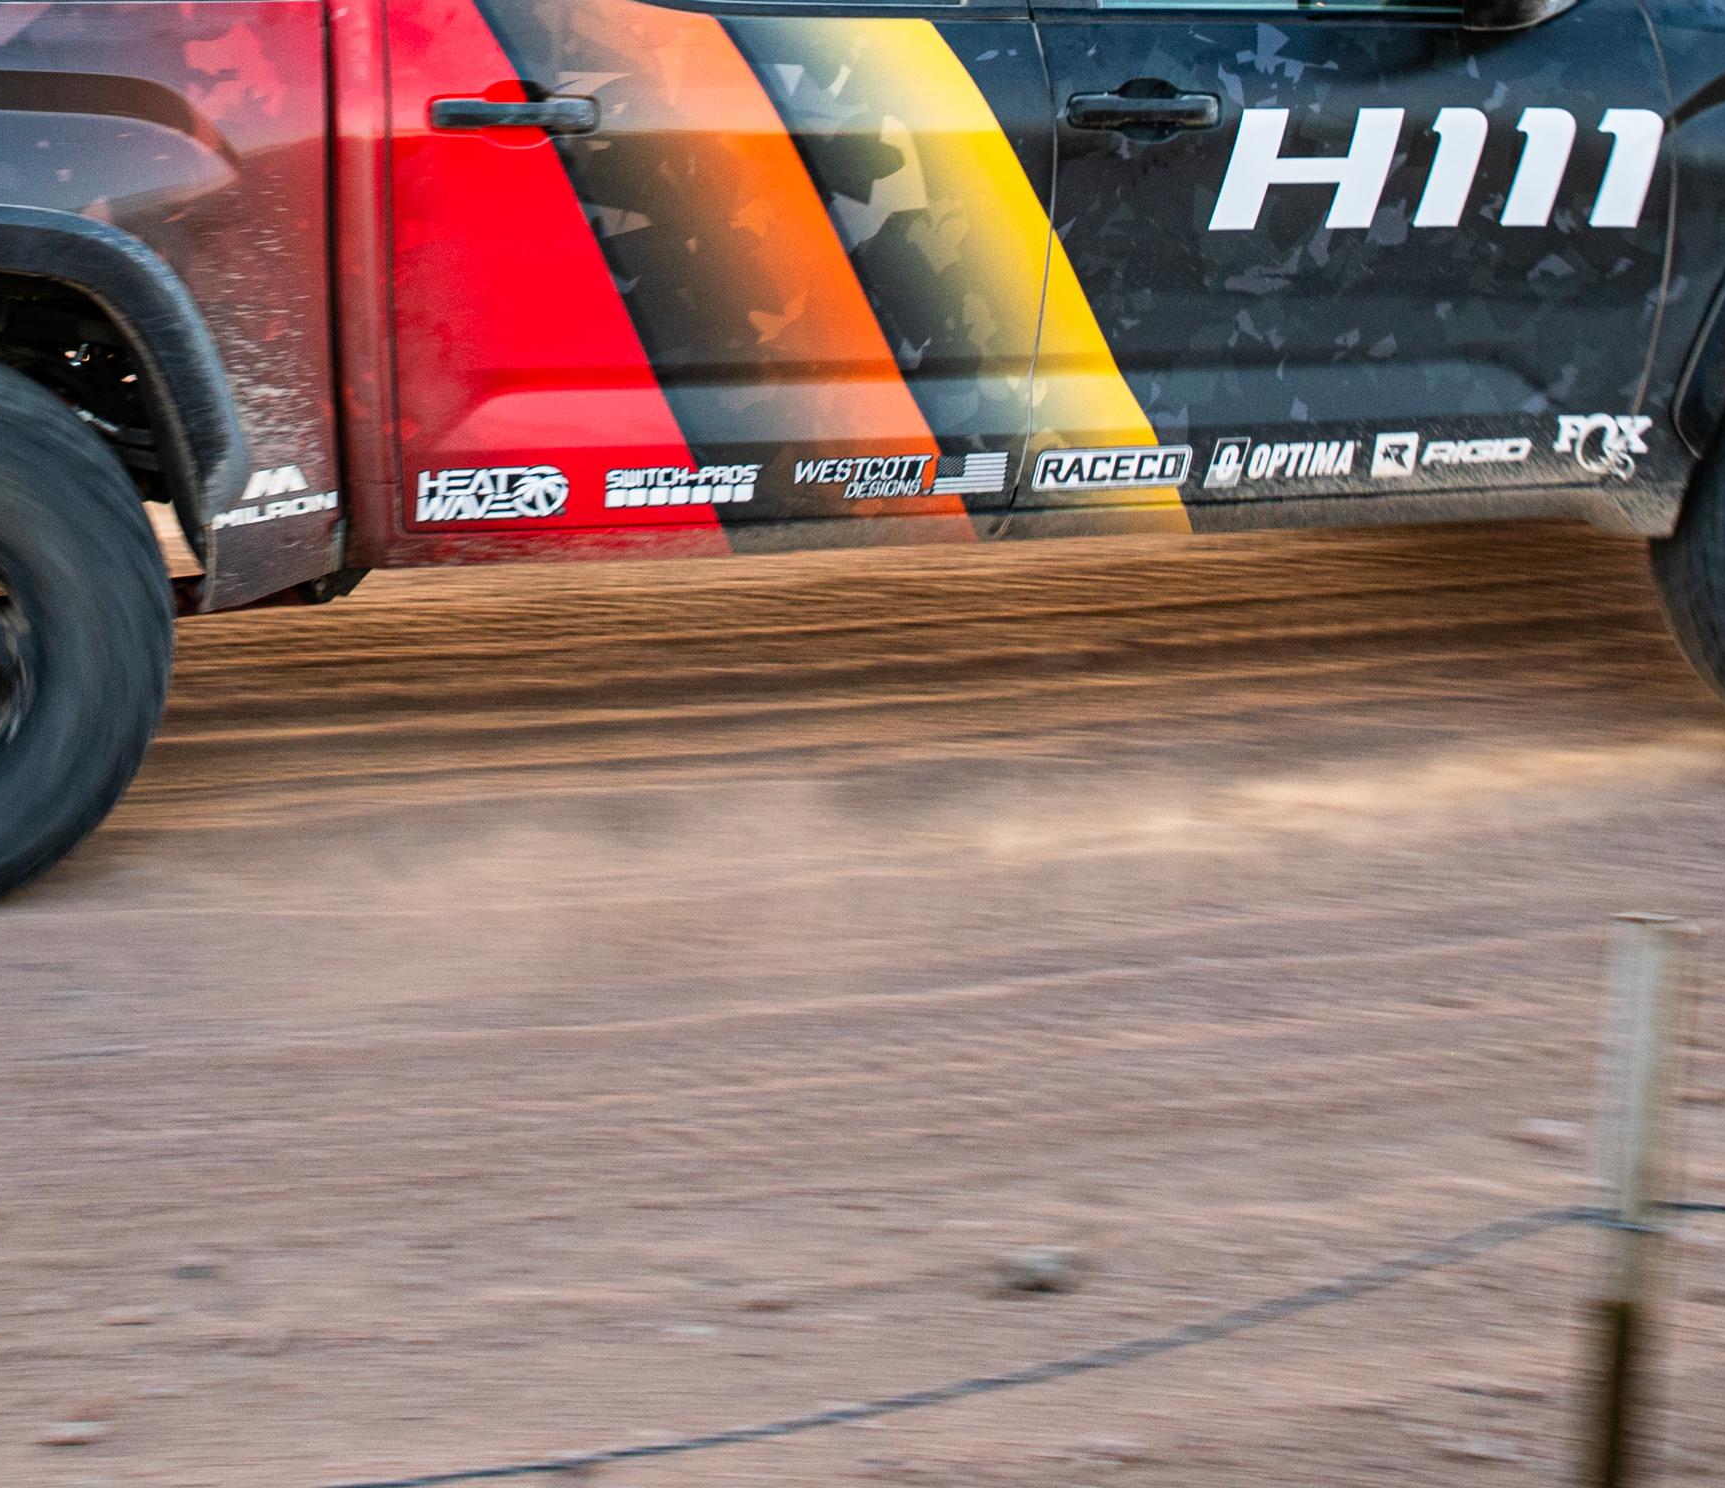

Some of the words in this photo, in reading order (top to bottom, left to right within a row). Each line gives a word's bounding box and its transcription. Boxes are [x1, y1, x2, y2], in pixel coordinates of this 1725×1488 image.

[1208, 107, 1664, 230] H111
[1248, 440, 1356, 480] OPTIMA
[1421, 437, 1533, 464] RIGID
[1553, 413, 1653, 480] FOX
[418, 467, 528, 496] HEAT
[605, 464, 761, 489] SWITCH-PROS
[794, 455, 932, 485] WESTCOTT
[1039, 453, 1186, 484] RACECO
[843, 479, 922, 499] DESIGNS
[415, 493, 524, 522] WAVE
